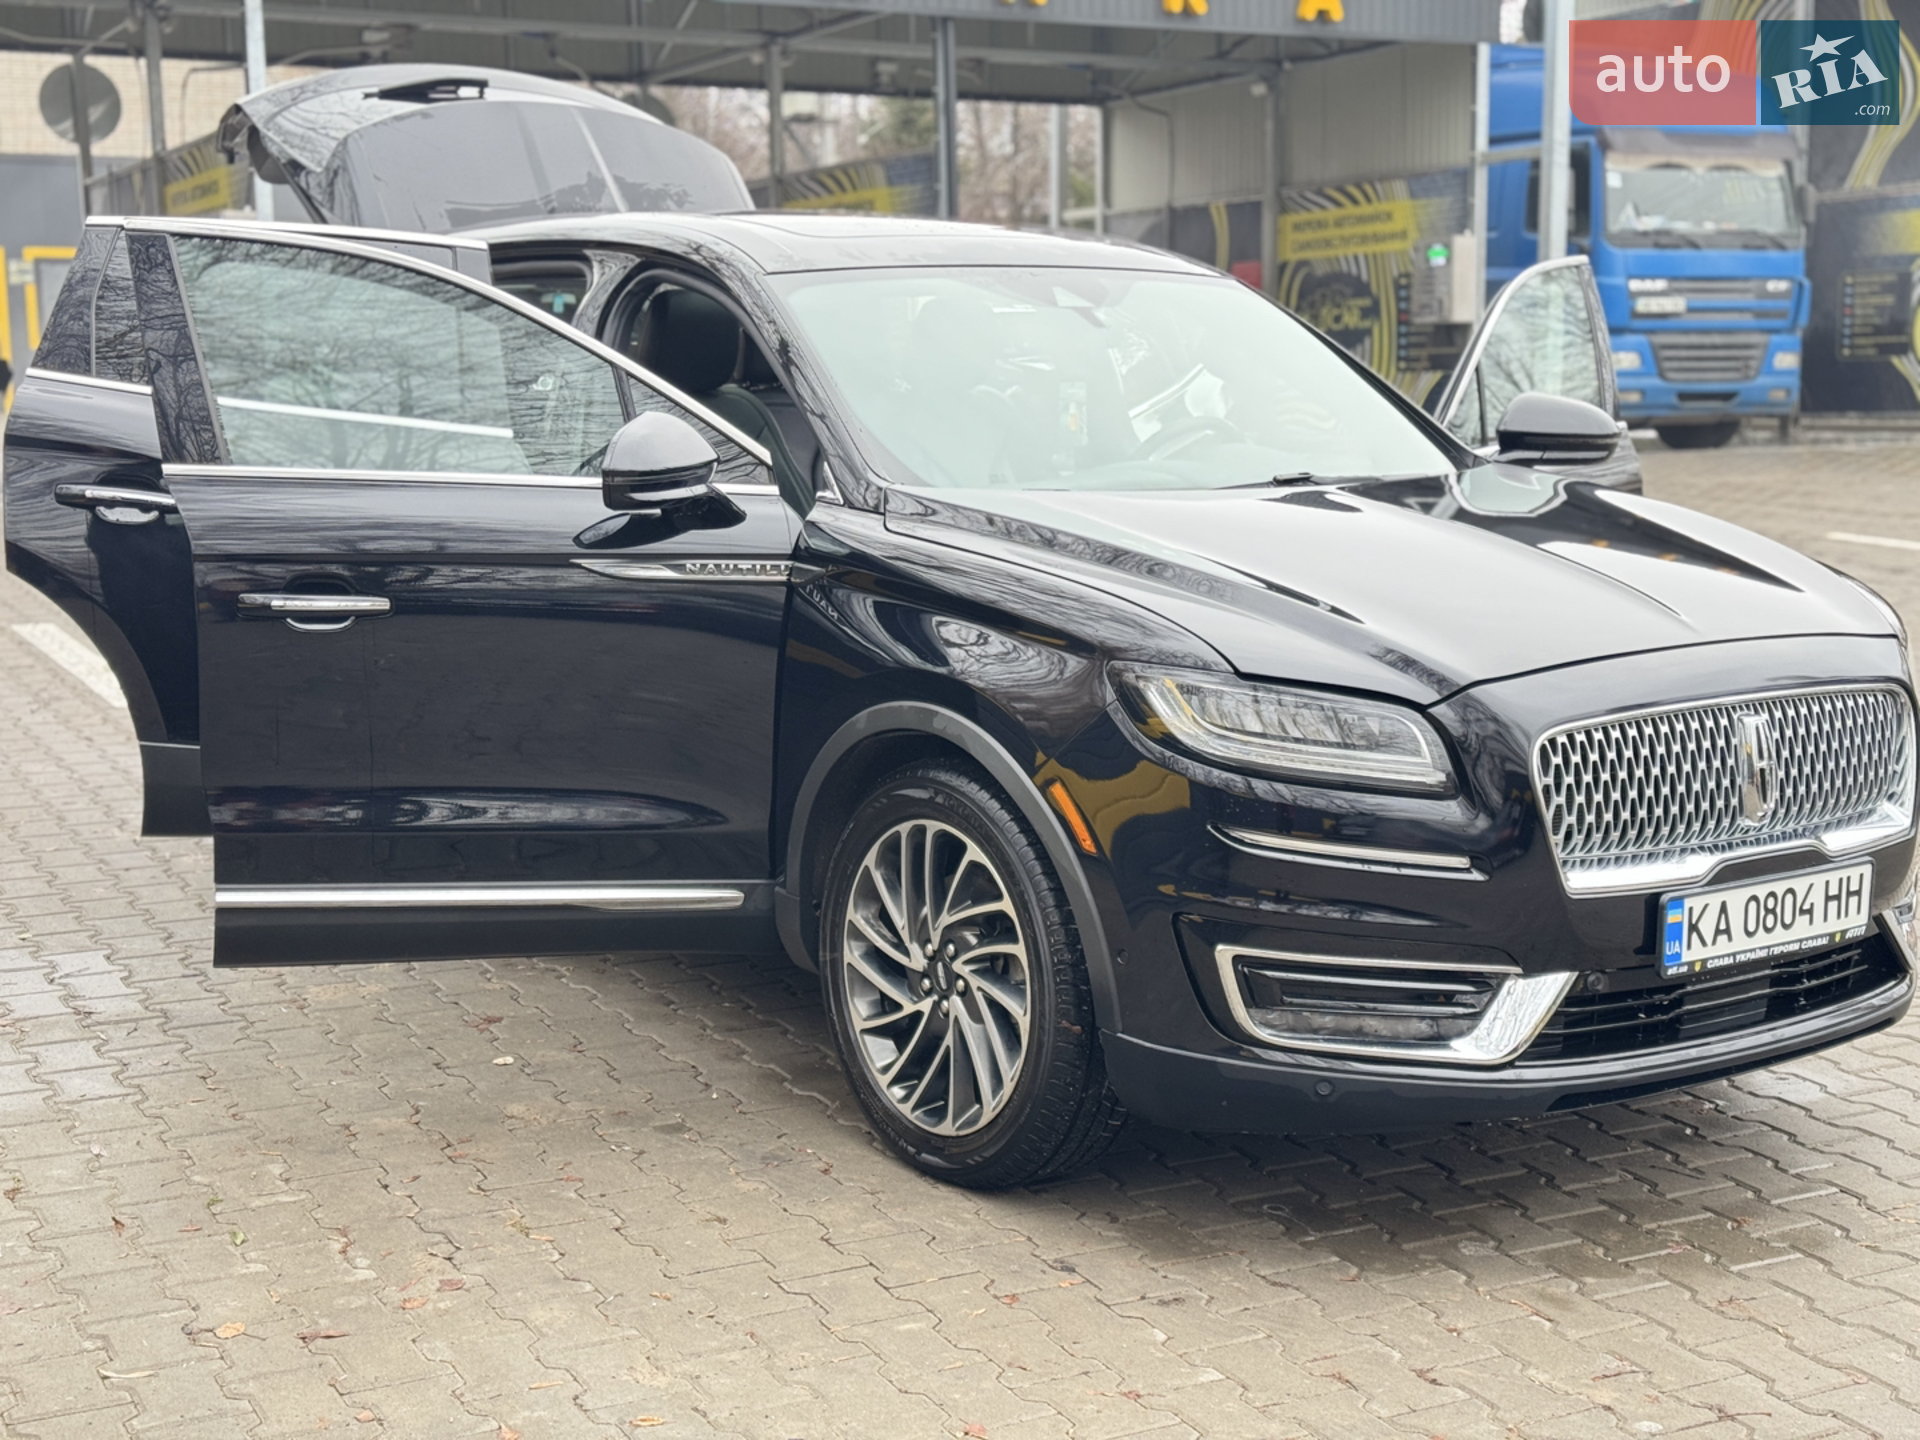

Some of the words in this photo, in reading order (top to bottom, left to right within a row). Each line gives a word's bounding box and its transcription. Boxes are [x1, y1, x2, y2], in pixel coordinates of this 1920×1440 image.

[1686, 900, 1733, 951] KA
[1743, 882, 1815, 938] 0804
[1823, 873, 1864, 923] HH
[1666, 941, 1680, 955] UA
[1707, 957, 1734, 968] СЛАВА
[1769, 941, 1800, 956] ГЕРОЯМ
